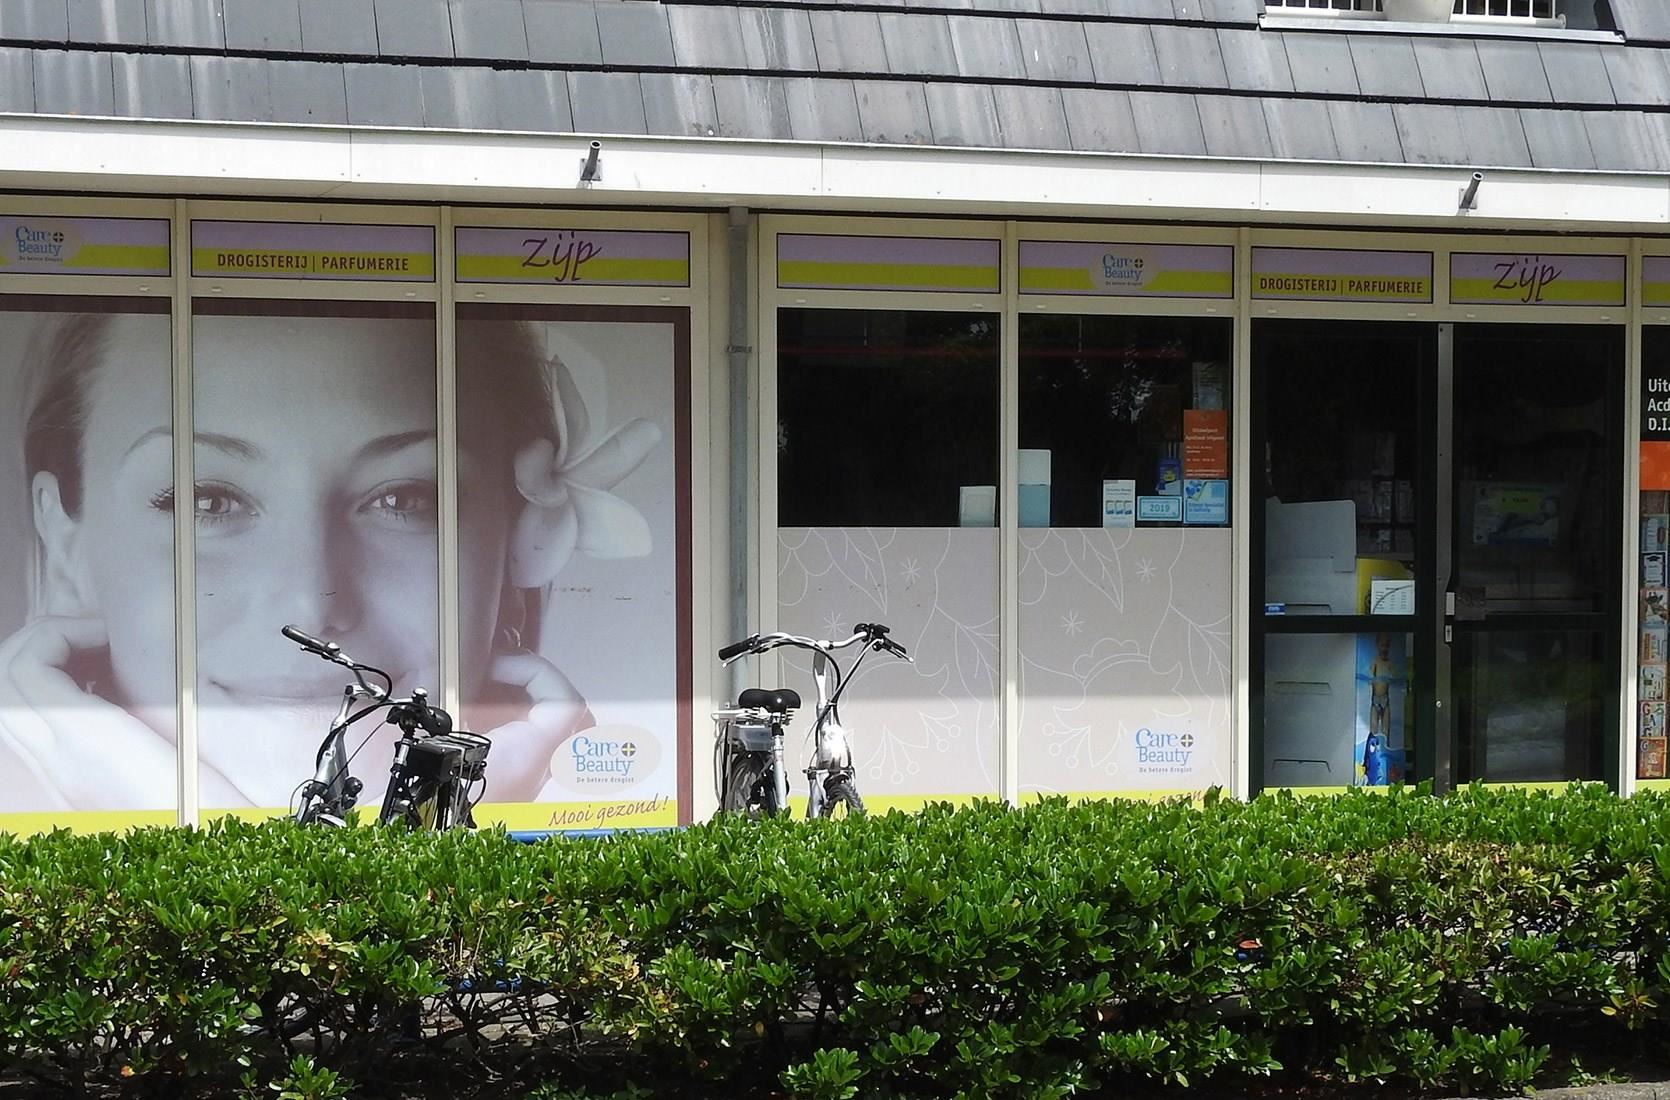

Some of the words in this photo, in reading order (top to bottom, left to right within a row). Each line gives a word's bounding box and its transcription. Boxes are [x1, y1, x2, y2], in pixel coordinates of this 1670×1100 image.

[17, 240, 63, 256] Beauty
[522, 231, 602, 282] Zijp
[217, 254, 308, 269] DROGISTERIJ
[322, 256, 409, 271] PARFUMERIE
[1104, 266, 1142, 281] Beauty
[1493, 256, 1562, 303] Zijp
[1260, 278, 1337, 292] DROGISTERIJ
[1349, 280, 1423, 293] PARFUMERIE
[1149, 503, 1170, 512] 2019
[572, 736, 619, 757] Care
[1135, 728, 1178, 748] Care
[572, 755, 634, 776] Beauty
[1136, 746, 1192, 766] Beauty
[548, 804, 594, 827] Mooi
